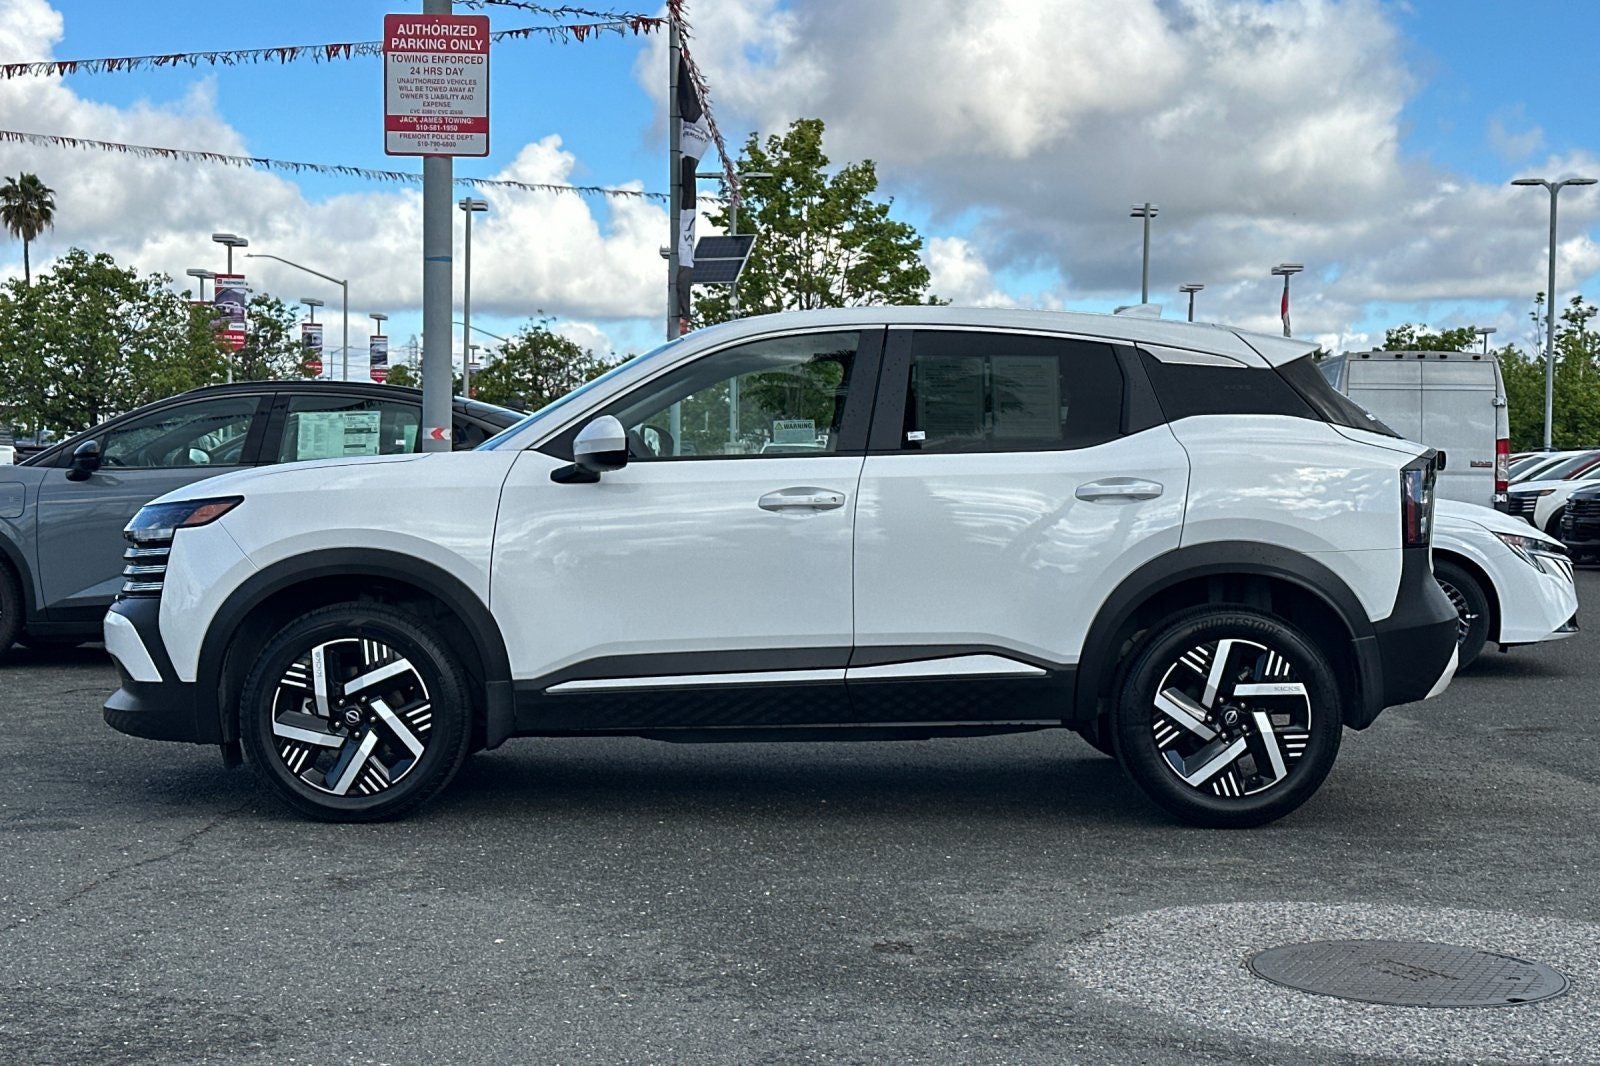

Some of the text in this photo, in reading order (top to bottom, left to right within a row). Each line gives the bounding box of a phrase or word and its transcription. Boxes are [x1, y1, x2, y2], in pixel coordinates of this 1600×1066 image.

[397, 24, 477, 37] AUTHORIZED
[391, 38, 483, 51] PARKING ONLY
[391, 54, 484, 65] TOWING ENFORCED
[410, 67, 464, 76] 24 HRS DAY
[444, 117, 474, 125] TOWING:
[1190, 617, 1282, 637] BRIDGESTONE
[314, 651, 322, 677] KICKS
